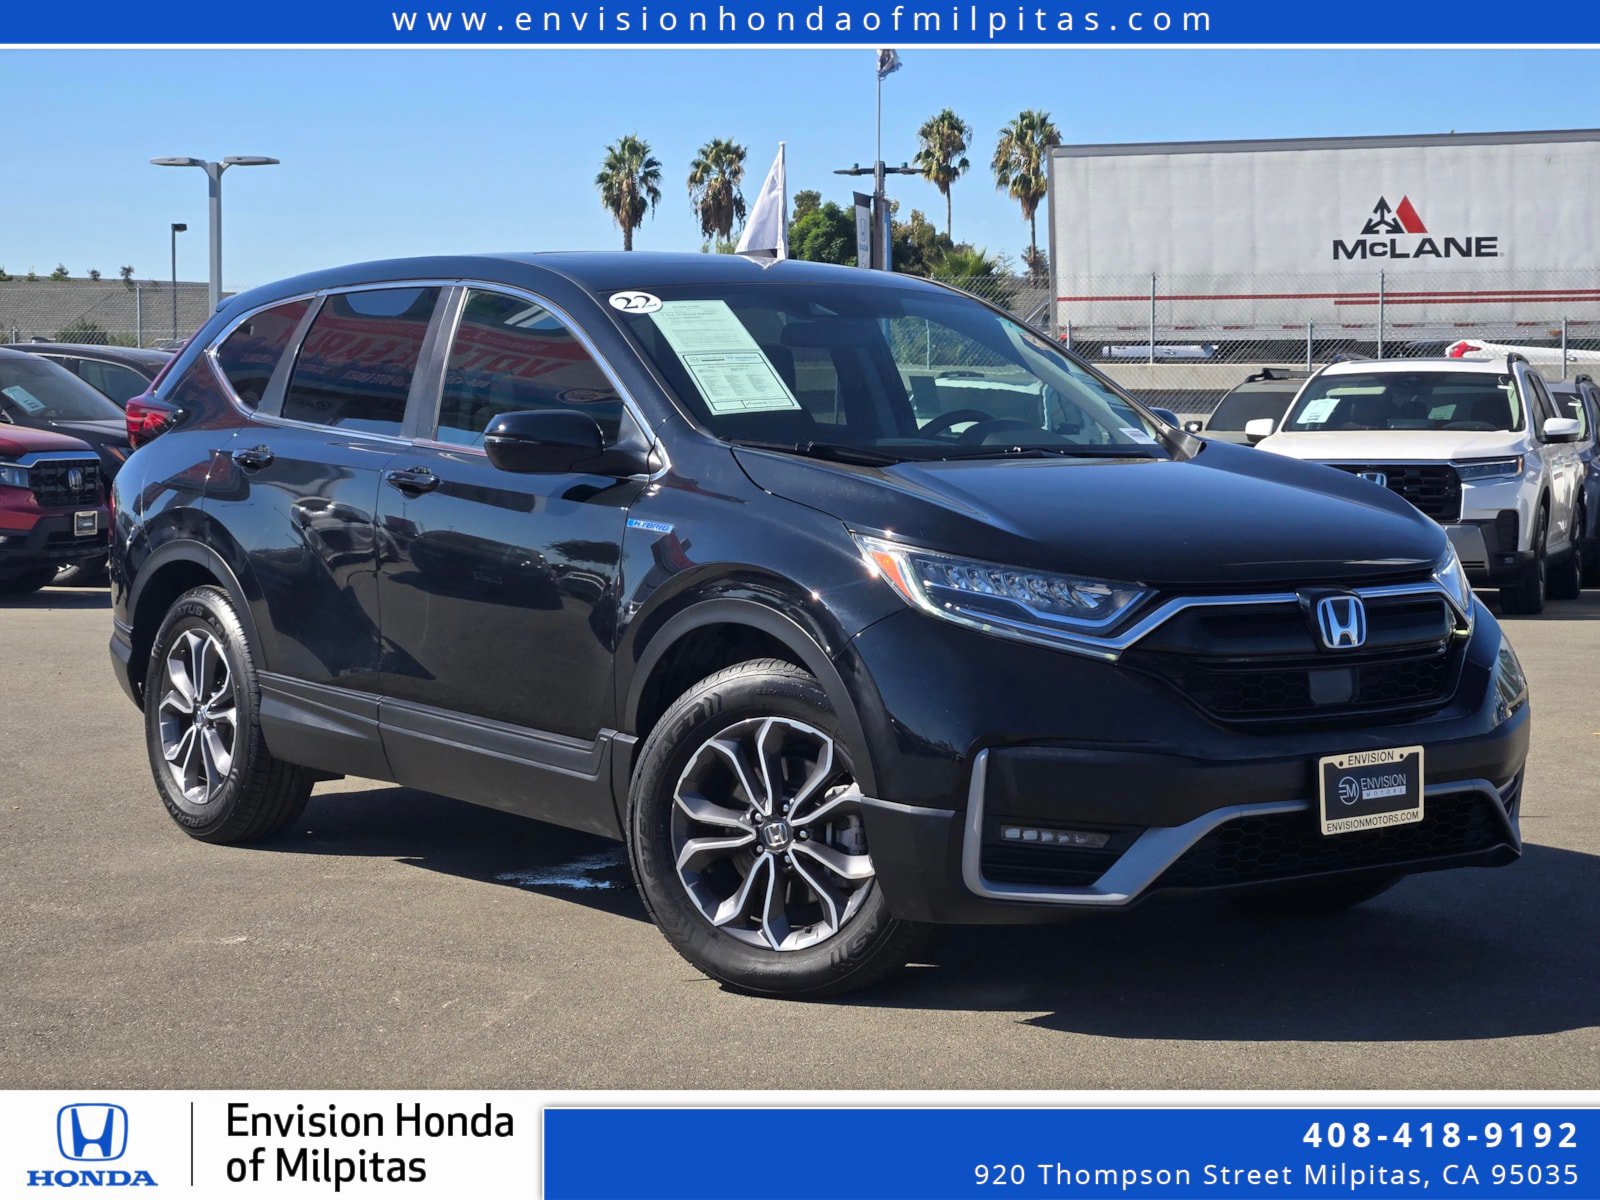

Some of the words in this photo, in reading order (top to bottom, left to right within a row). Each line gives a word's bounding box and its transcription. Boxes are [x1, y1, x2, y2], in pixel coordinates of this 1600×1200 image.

[1333, 236, 1499, 260] McLANE
[614, 295, 657, 310] 22
[633, 519, 670, 532] HYBRID
[1347, 751, 1394, 766] ENVISION
[1360, 774, 1406, 789] ENVISION
[1366, 788, 1404, 798] MOTORS
[1326, 810, 1419, 833] ENVISIONMOTORS.COM
